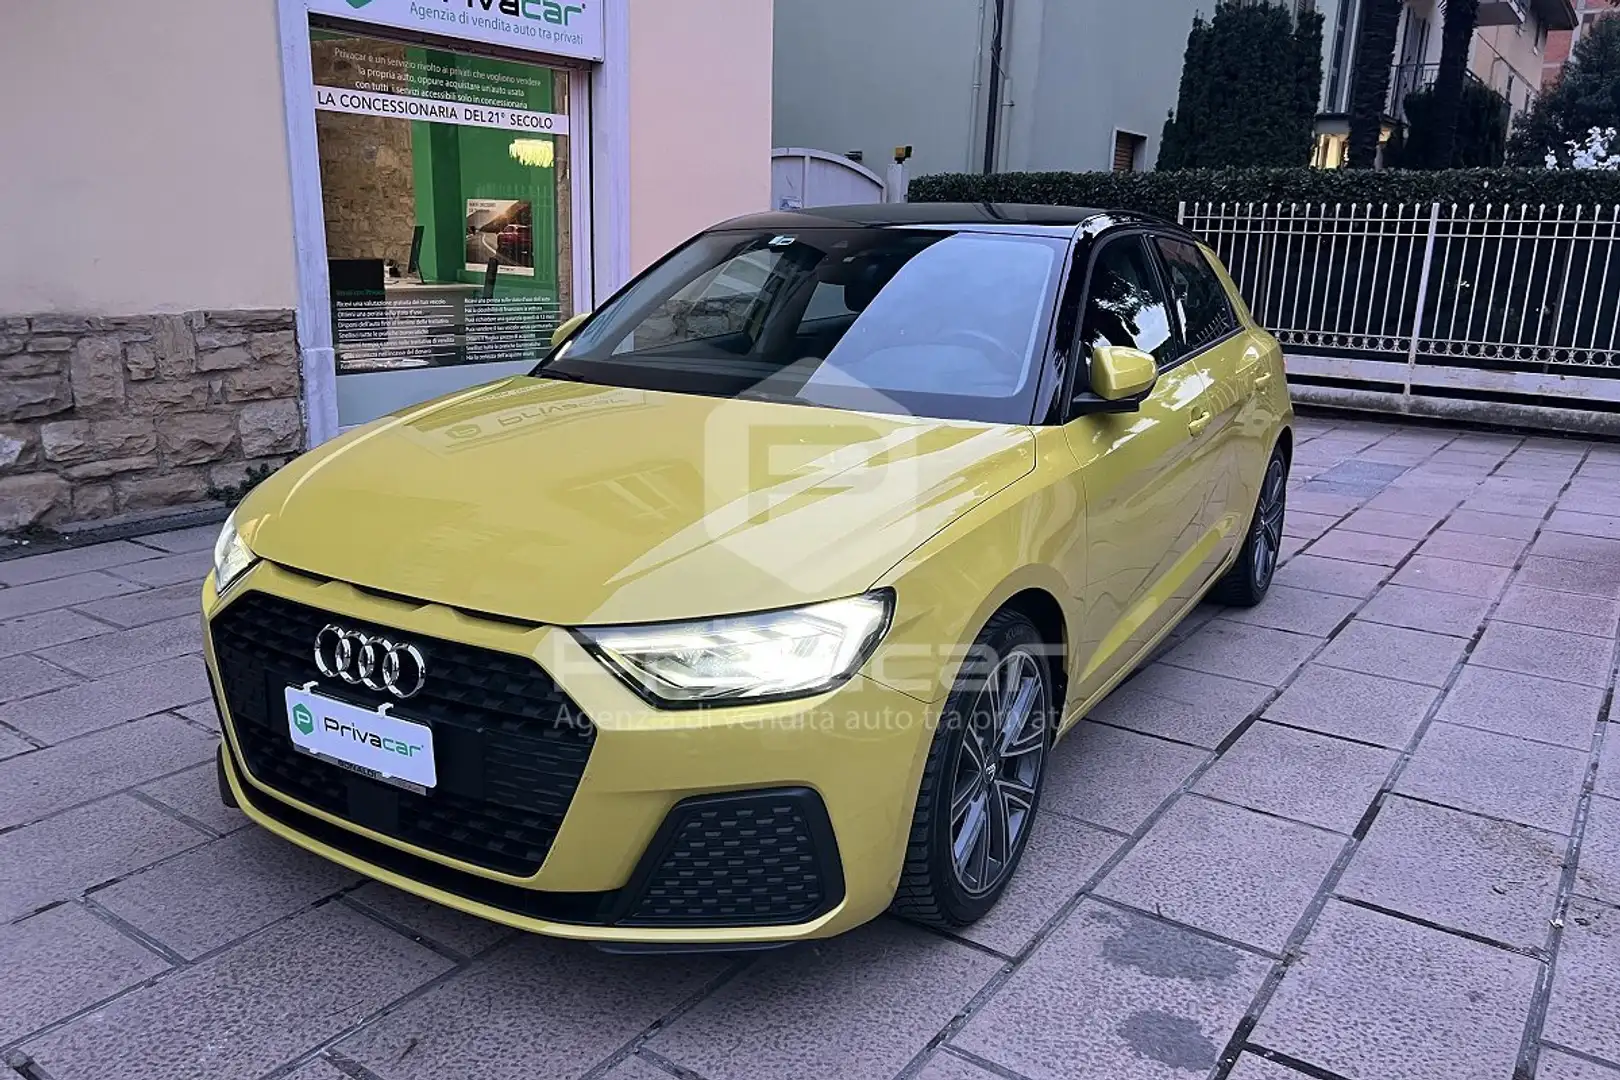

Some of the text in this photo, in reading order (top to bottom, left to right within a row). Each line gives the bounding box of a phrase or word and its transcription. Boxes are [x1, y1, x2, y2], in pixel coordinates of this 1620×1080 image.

[410, 1, 583, 45] Agenzia di vendita auto tra privati
[367, 68, 396, 80] propria
[417, 75, 444, 88] oppure
[445, 79, 481, 92] acquistare
[507, 88, 526, 98] usata
[387, 58, 416, 69] servizio
[486, 72, 515, 84] vogliono
[317, 90, 336, 106] LA
[340, 93, 458, 120] CONCESSIONARIA
[510, 113, 554, 130] SECOLO
[355, 81, 371, 90] con
[372, 82, 389, 92] tutti
[396, 86, 420, 96] servizi
[421, 90, 457, 101] accessibili
[457, 92, 472, 103] solo
[473, 95, 480, 104] in
[480, 96, 528, 110] concessionaria
[323, 716, 422, 758] Privacar
